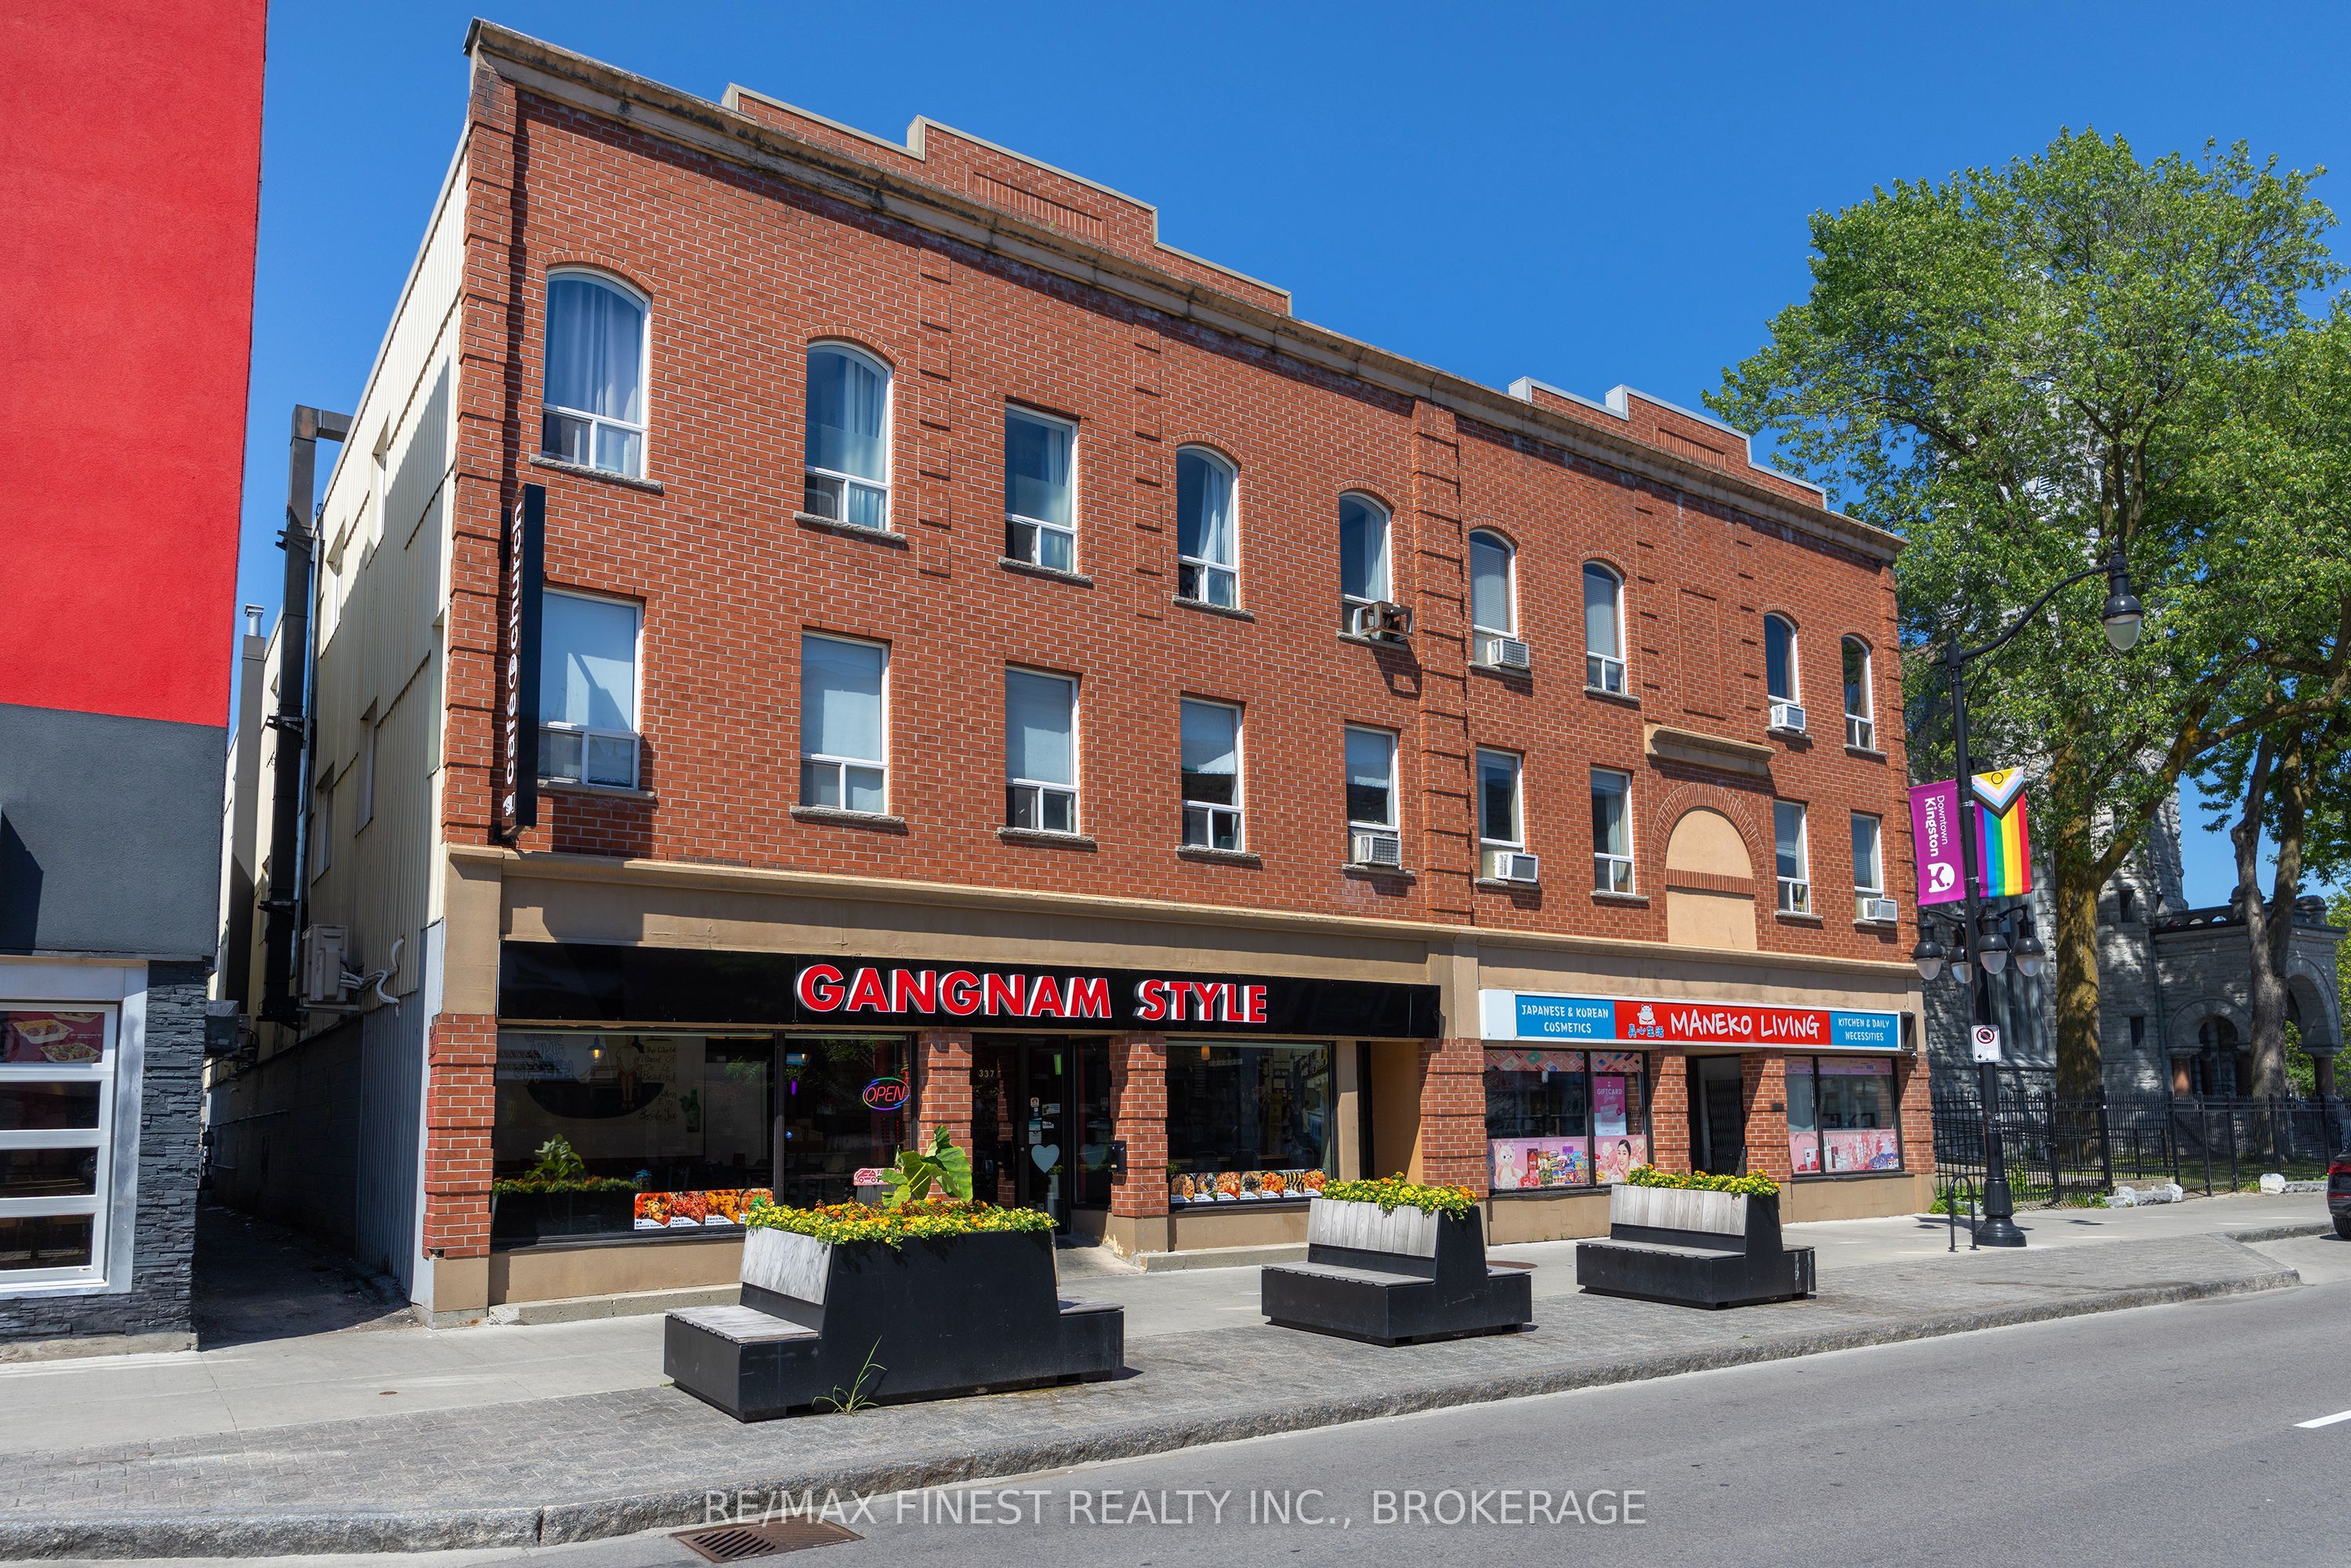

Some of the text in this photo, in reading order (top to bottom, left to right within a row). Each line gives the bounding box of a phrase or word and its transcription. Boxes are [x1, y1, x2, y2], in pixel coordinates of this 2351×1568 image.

[1925, 797, 1939, 857] Kingston
[1937, 795, 1948, 845] Downtown
[796, 963, 1267, 1023] GANGNAM STYLE
[1521, 1004, 1609, 1019] JAPANESE & KOREAN
[1544, 1021, 1592, 1034] COSMETICS
[1670, 1009, 1820, 1039] MANEKO LIVING
[1838, 1017, 1889, 1029] KITCHEN & DAILY
[1845, 1030, 1884, 1041] NECESSITIES
[979, 1070, 994, 1078] 337
[865, 1085, 905, 1102] OPEN
